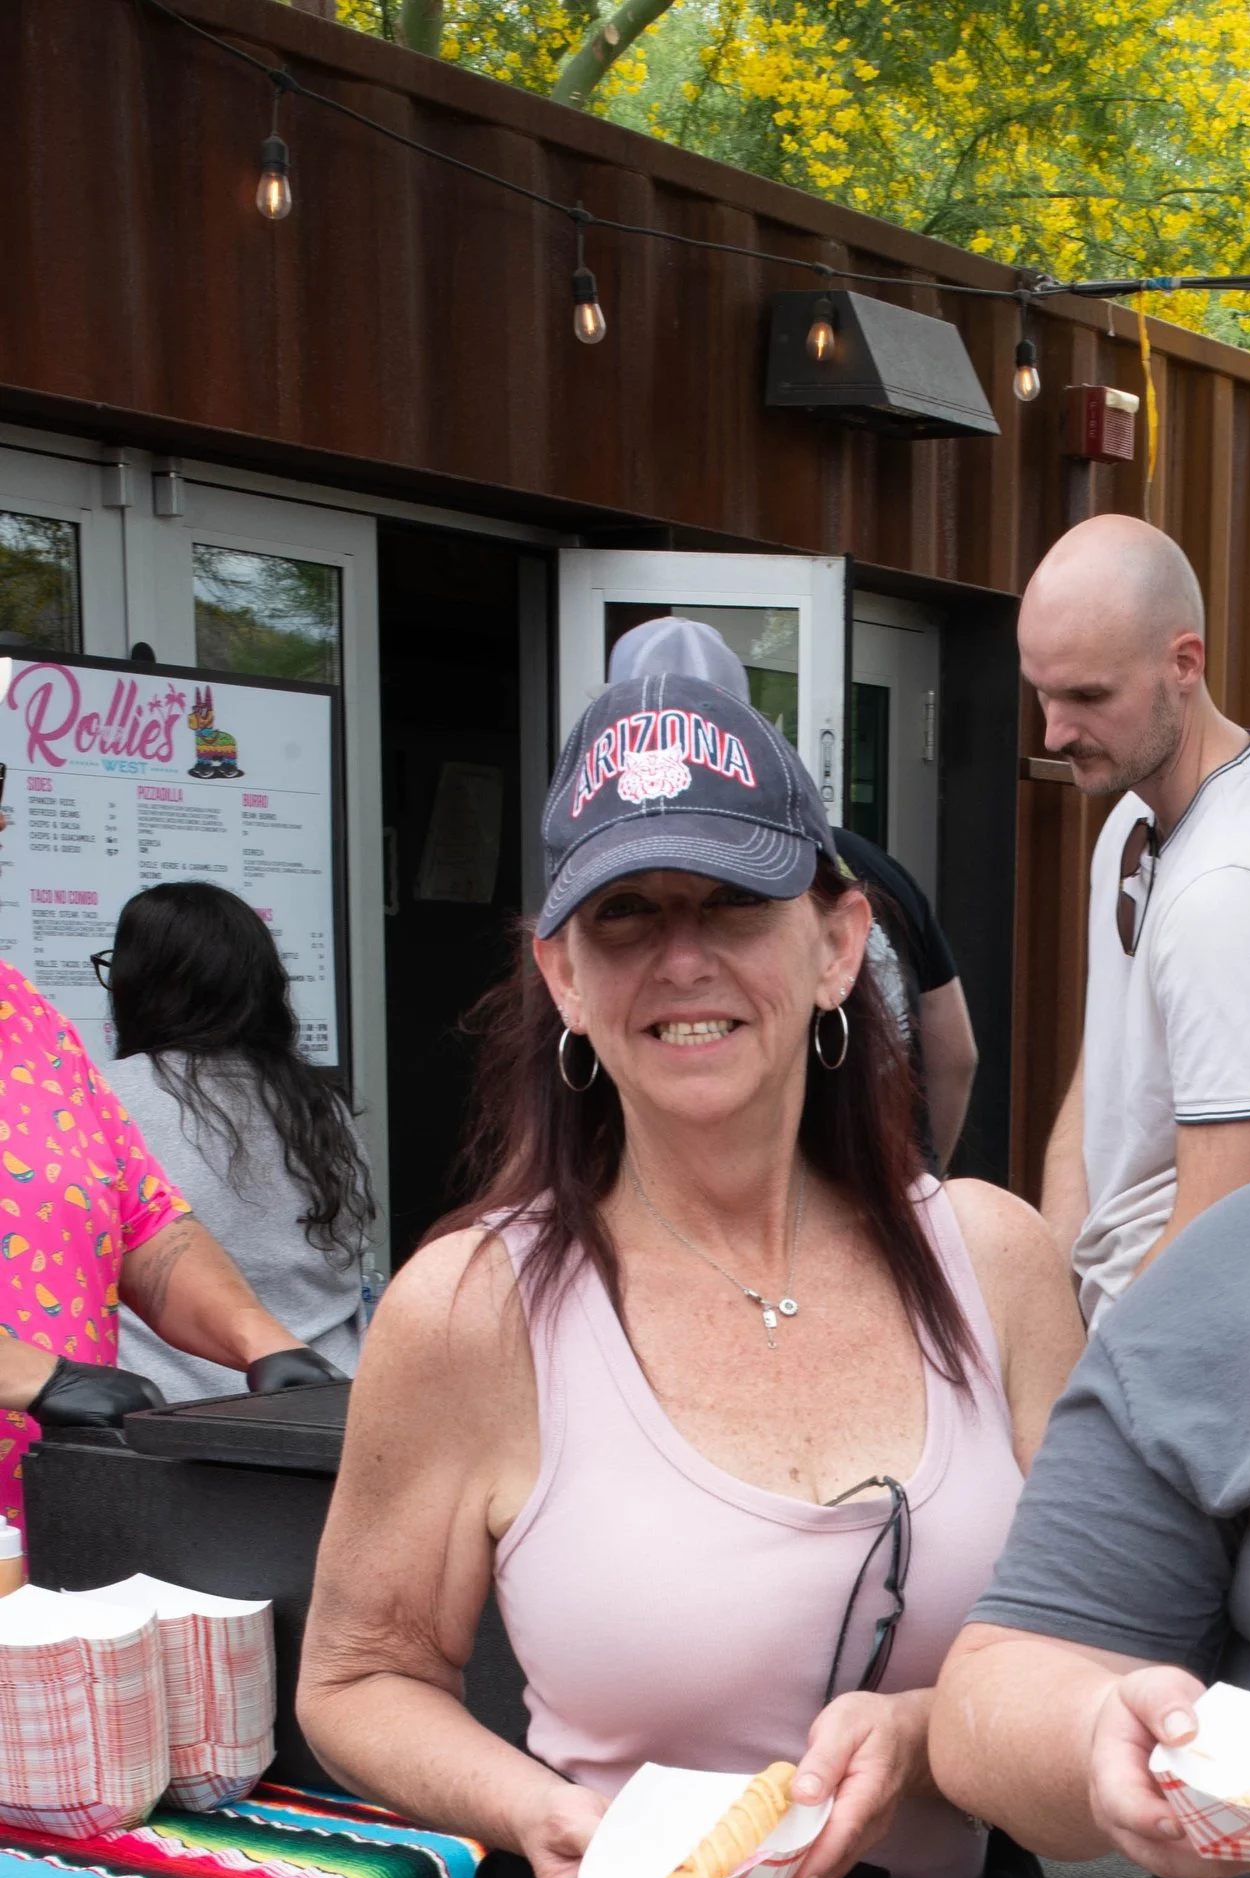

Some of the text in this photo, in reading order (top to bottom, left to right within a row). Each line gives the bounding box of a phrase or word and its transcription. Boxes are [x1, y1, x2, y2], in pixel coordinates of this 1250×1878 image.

[101, 758, 148, 775] WEST
[571, 709, 756, 818] ARIZONA
[27, 776, 53, 792] SIDES
[30, 889, 53, 903] TACO
[68, 891, 98, 905] COMBO
